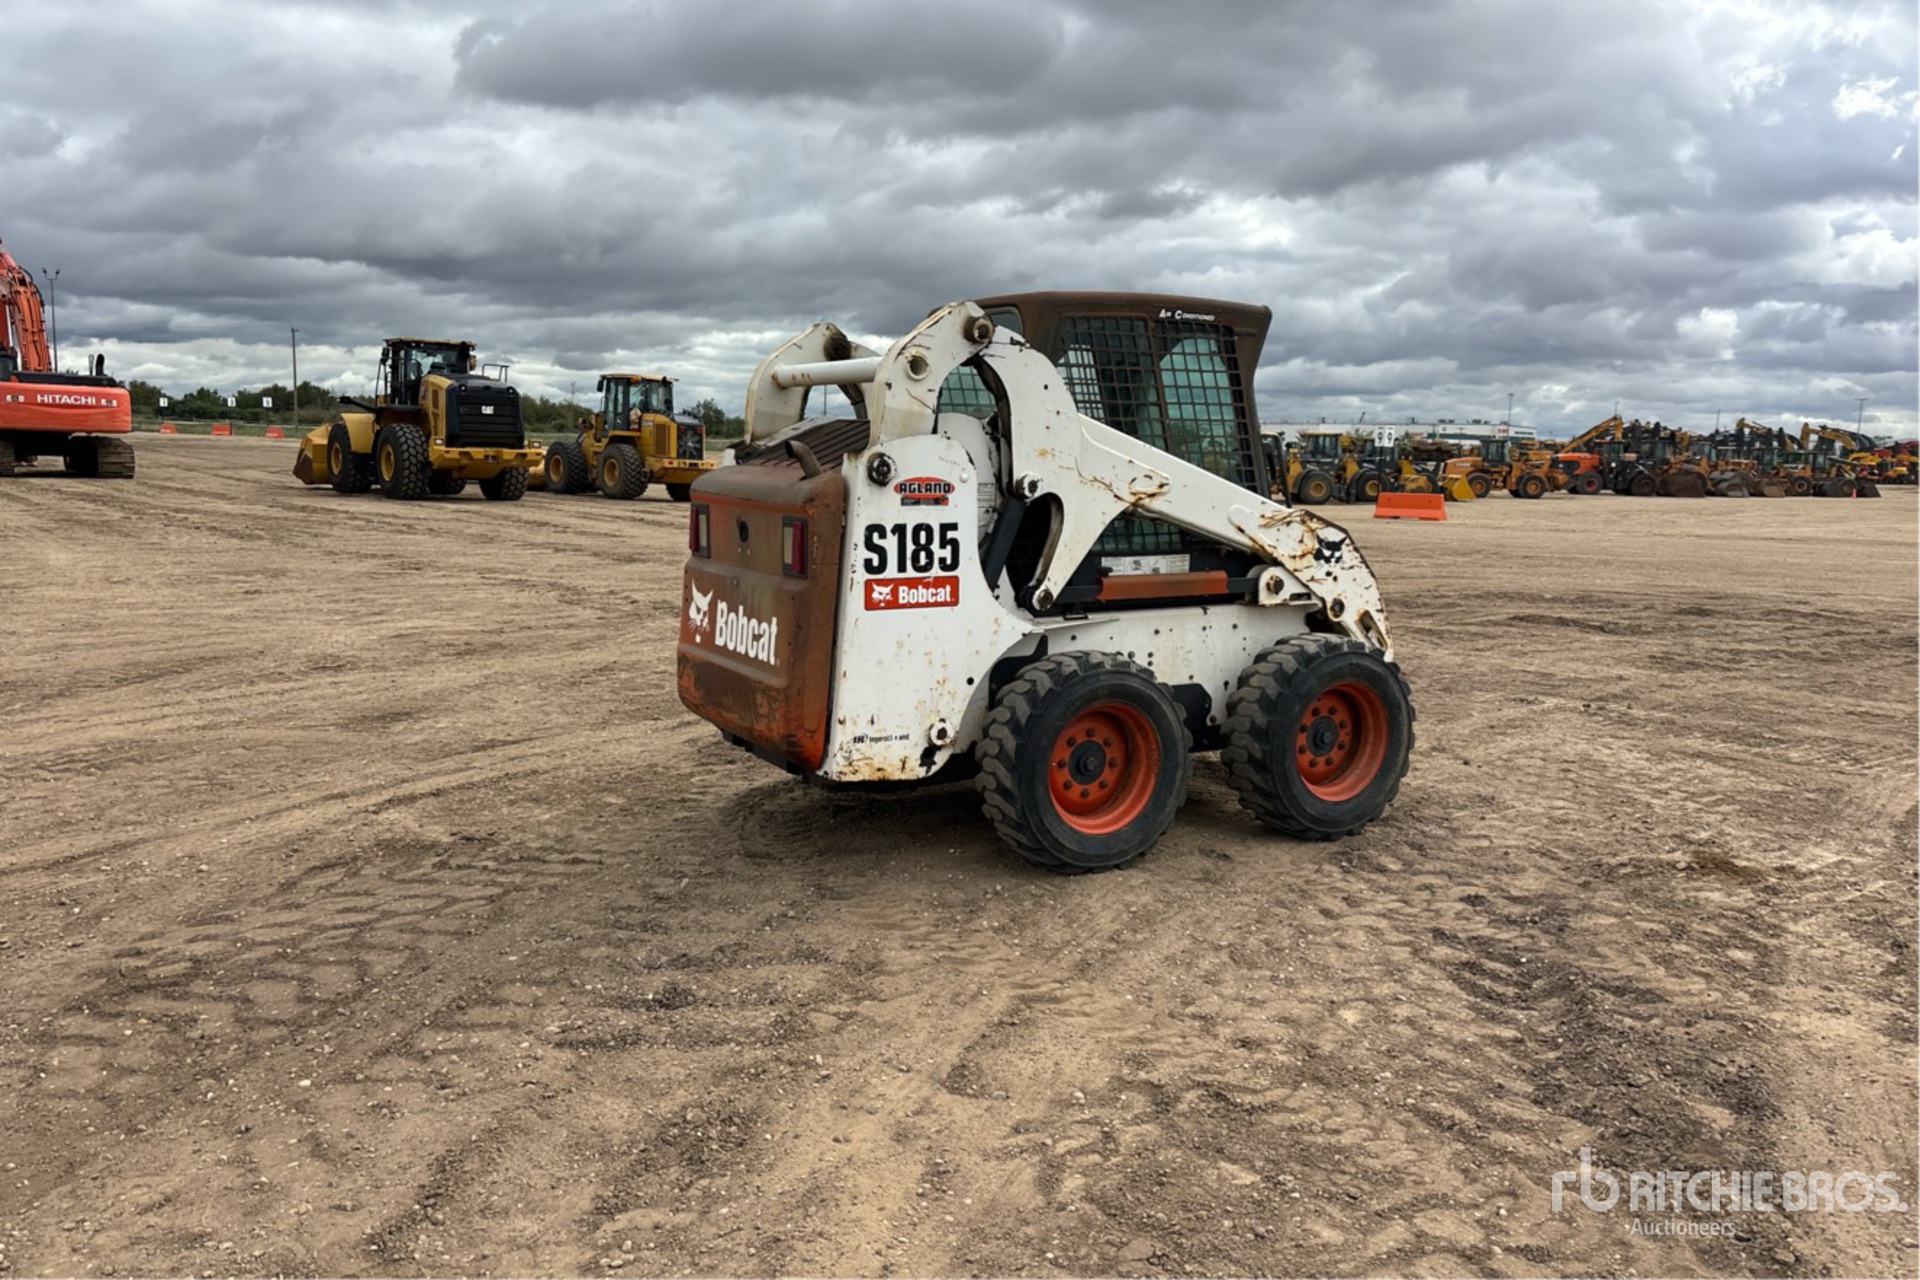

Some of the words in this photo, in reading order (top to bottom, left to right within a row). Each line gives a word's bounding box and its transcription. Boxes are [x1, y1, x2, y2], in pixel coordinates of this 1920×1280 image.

[36, 394, 97, 406] HITACHI
[1377, 431, 1384, 445] 9
[1386, 431, 1393, 445] 9
[899, 482, 951, 494] AGLAND
[863, 522, 960, 575] S185
[898, 584, 952, 604] Bobcat
[714, 599, 779, 666] Bobcat
